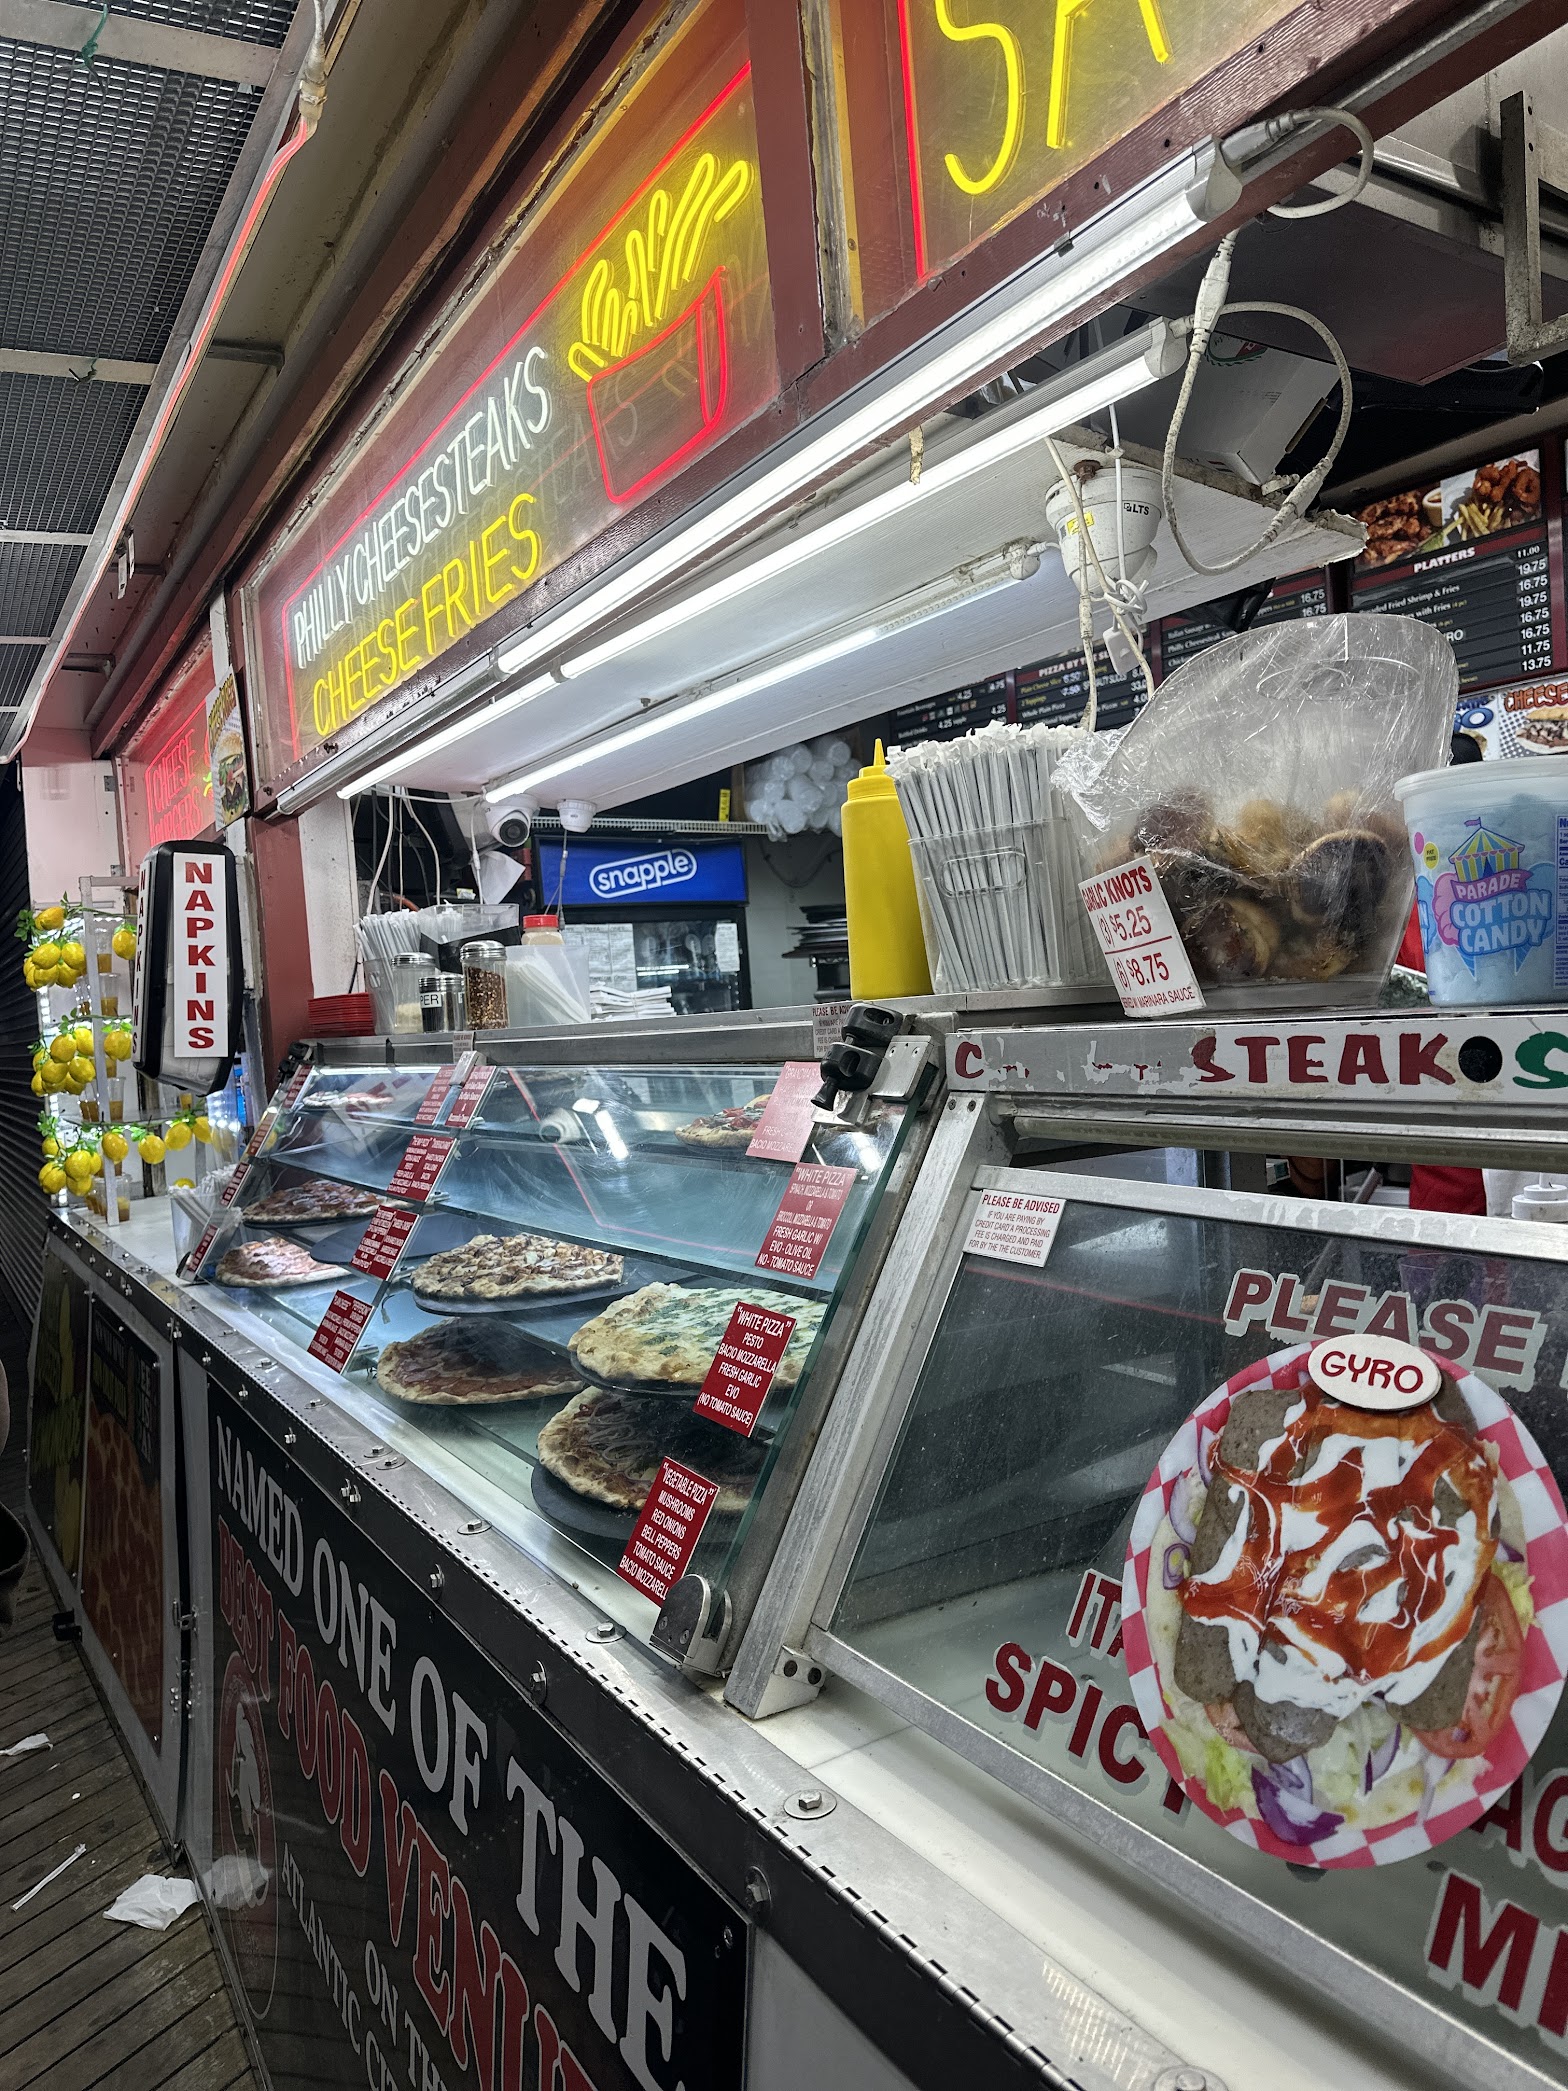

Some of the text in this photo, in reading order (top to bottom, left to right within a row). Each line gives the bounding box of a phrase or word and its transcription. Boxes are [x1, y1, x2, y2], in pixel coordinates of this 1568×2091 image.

[294, 346, 551, 670] PHILLY CHEESESTEAKS
[1133, 503, 1149, 515] LTS
[1414, 547, 1476, 573] PLATTERS
[1518, 557, 1547, 576] 19.75
[1301, 588, 1325, 603] 16.75
[1388, 585, 1460, 610] Fried Shrimp & Fries
[1518, 576, 1548, 593] 16.75
[1302, 603, 1327, 617] 16.75
[1519, 592, 1547, 608] 19.75
[313, 598, 422, 736] CHEESE
[423, 493, 542, 654] FRIES
[1520, 609, 1549, 624] 16.75
[1521, 625, 1550, 639] 16.75
[1521, 641, 1550, 656] 11.75
[1038, 658, 1079, 677] PIZZA BY
[1522, 657, 1552, 672] 13.75
[153, 729, 196, 813] CHEESE
[598, 855, 689, 891] snapple
[1104, 866, 1152, 905] KNOTS
[1456, 873, 1521, 900] PARADE
[1109, 905, 1152, 941] $5.25
[1453, 892, 1549, 927] COTTON
[1461, 918, 1543, 952] CANDY
[132, 869, 146, 1054] NAPKINS
[184, 862, 216, 1049] NAPKINS
[1113, 952, 1170, 992] (6) $8.75
[1168, 986, 1195, 1003] SAUCE
[812, 1006, 838, 1017] PLEASE BE
[1191, 1032, 1456, 1086] STEAK
[982, 1194, 1060, 1214] PLEASE BE ADVISED
[975, 1219, 994, 1229] CREDIT
[994, 1222, 1009, 1232] CARD
[1014, 1225, 1051, 1238] PROCESSING
[987, 1210, 1045, 1226] IF YOU ARE PAYING BY
[773, 1226, 792, 1240] FRESH
[791, 1229, 815, 1244] GARLIC
[969, 1239, 979, 1248] FOR
[979, 1240, 987, 1249] BY
[987, 1242, 997, 1251] THE
[998, 1244, 1009, 1253] THE
[974, 1229, 1043, 1248] FEE IS CHARGED AND PAID
[769, 1240, 813, 1260] EVO OLIVE OIL
[770, 1256, 794, 1272] TOMATO
[792, 1260, 815, 1277] SAUCE
[1226, 1272, 1537, 1375] PLEASE
[742, 1332, 764, 1349] PESTO
[718, 1342, 777, 1374] BACIO MOZZARELLA
[718, 1362, 762, 1388] FRESH GARLIC
[1321, 1351, 1424, 1394] GYRO
[725, 1384, 740, 1399] EVO
[697, 1392, 753, 1429] (NO TOMATO SAUCE)
[658, 1490, 696, 1522] MUSHROOMS
[651, 1508, 687, 1540] RED ONIONS
[641, 1524, 682, 1560] BELL PEPPERS
[633, 1541, 676, 1580] TOMATO SAUCE
[619, 1555, 669, 1601] BACIO MOZZARELL
[218, 1515, 274, 1702] BEST
[277, 1608, 371, 1877] FOOD
[985, 1642, 1186, 1815] SPIC
[217, 1416, 304, 1597] NAMED
[313, 1538, 397, 1736] ONE
[410, 1656, 488, 1836] OF
[507, 1756, 687, 2091] THE
[282, 1842, 362, 2055] ATLANTIC
[365, 1940, 449, 2091] ON TH
